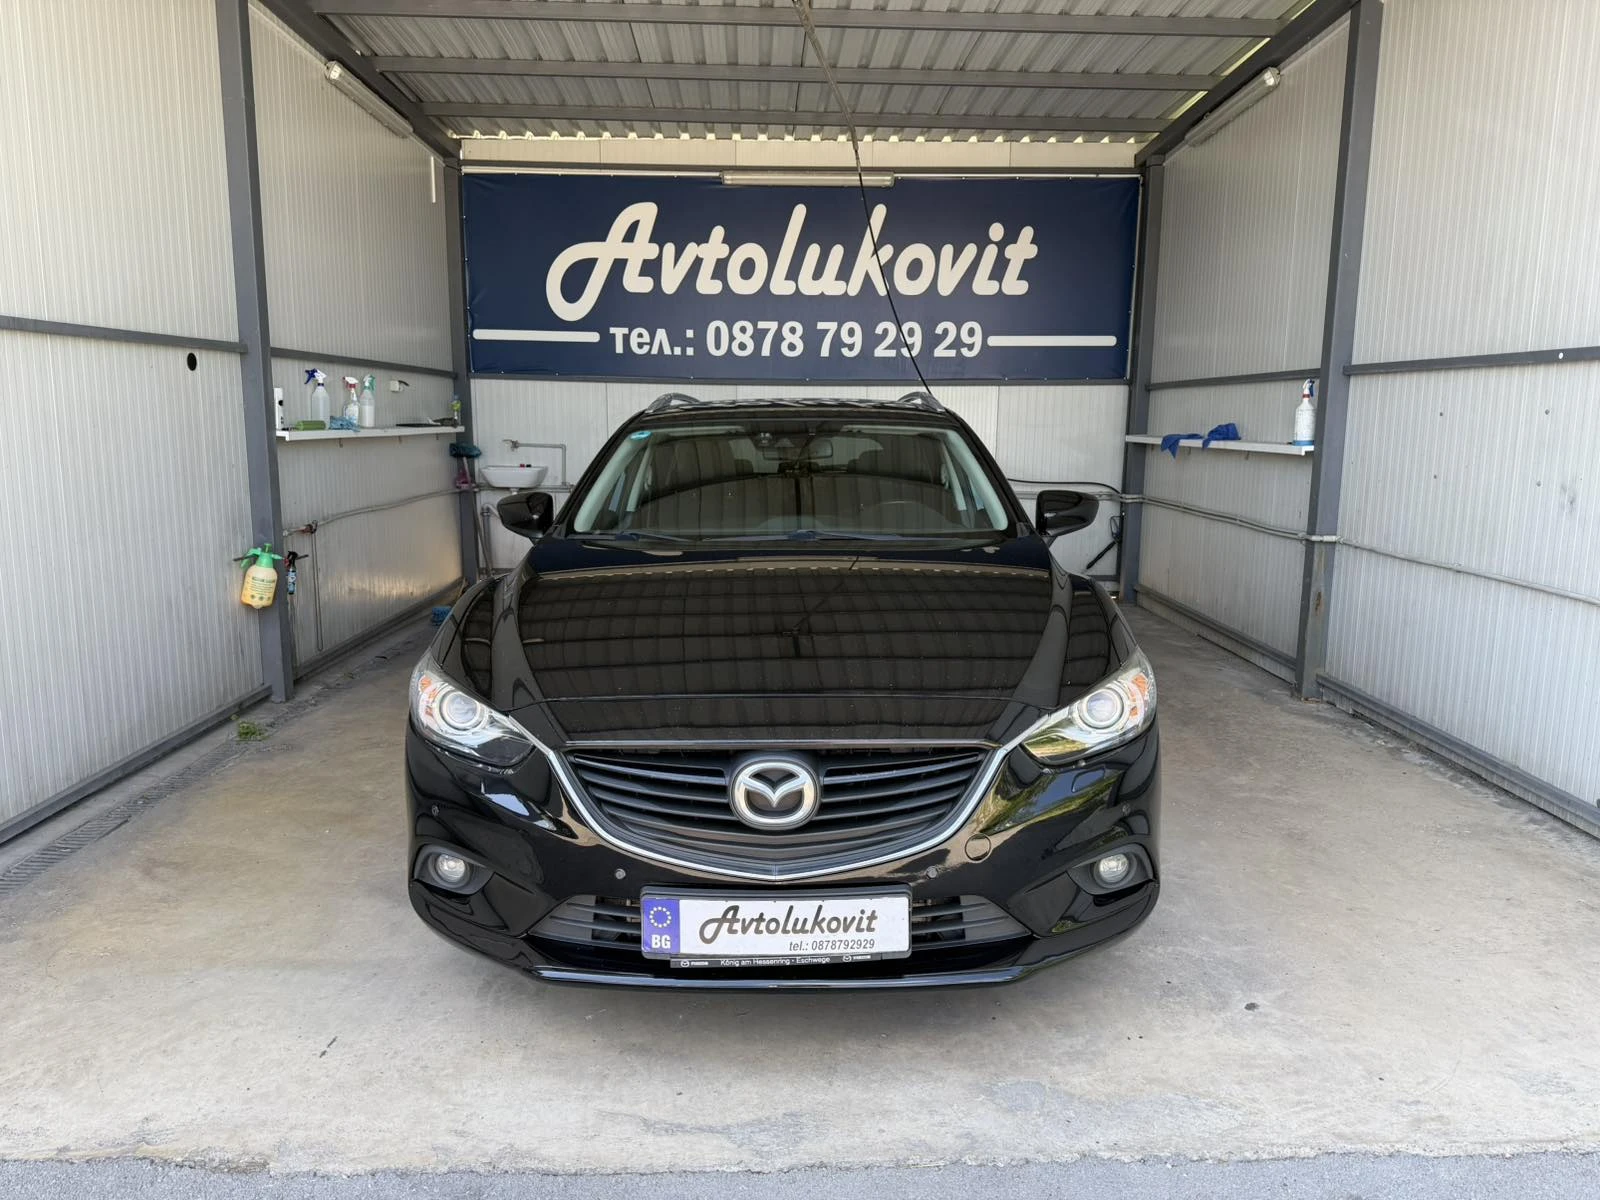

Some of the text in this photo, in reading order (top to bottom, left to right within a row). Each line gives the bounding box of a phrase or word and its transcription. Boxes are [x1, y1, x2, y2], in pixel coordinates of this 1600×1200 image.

[546, 202, 1039, 322] Avtolukovit
[609, 319, 983, 358] тел.: 0878 79 29 29
[699, 904, 879, 945] Avtolukovit
[651, 934, 671, 949] BG
[788, 938, 876, 952] tel.: 0878792929
[720, 959, 740, 967] König
[796, 956, 831, 964] Eschwege
